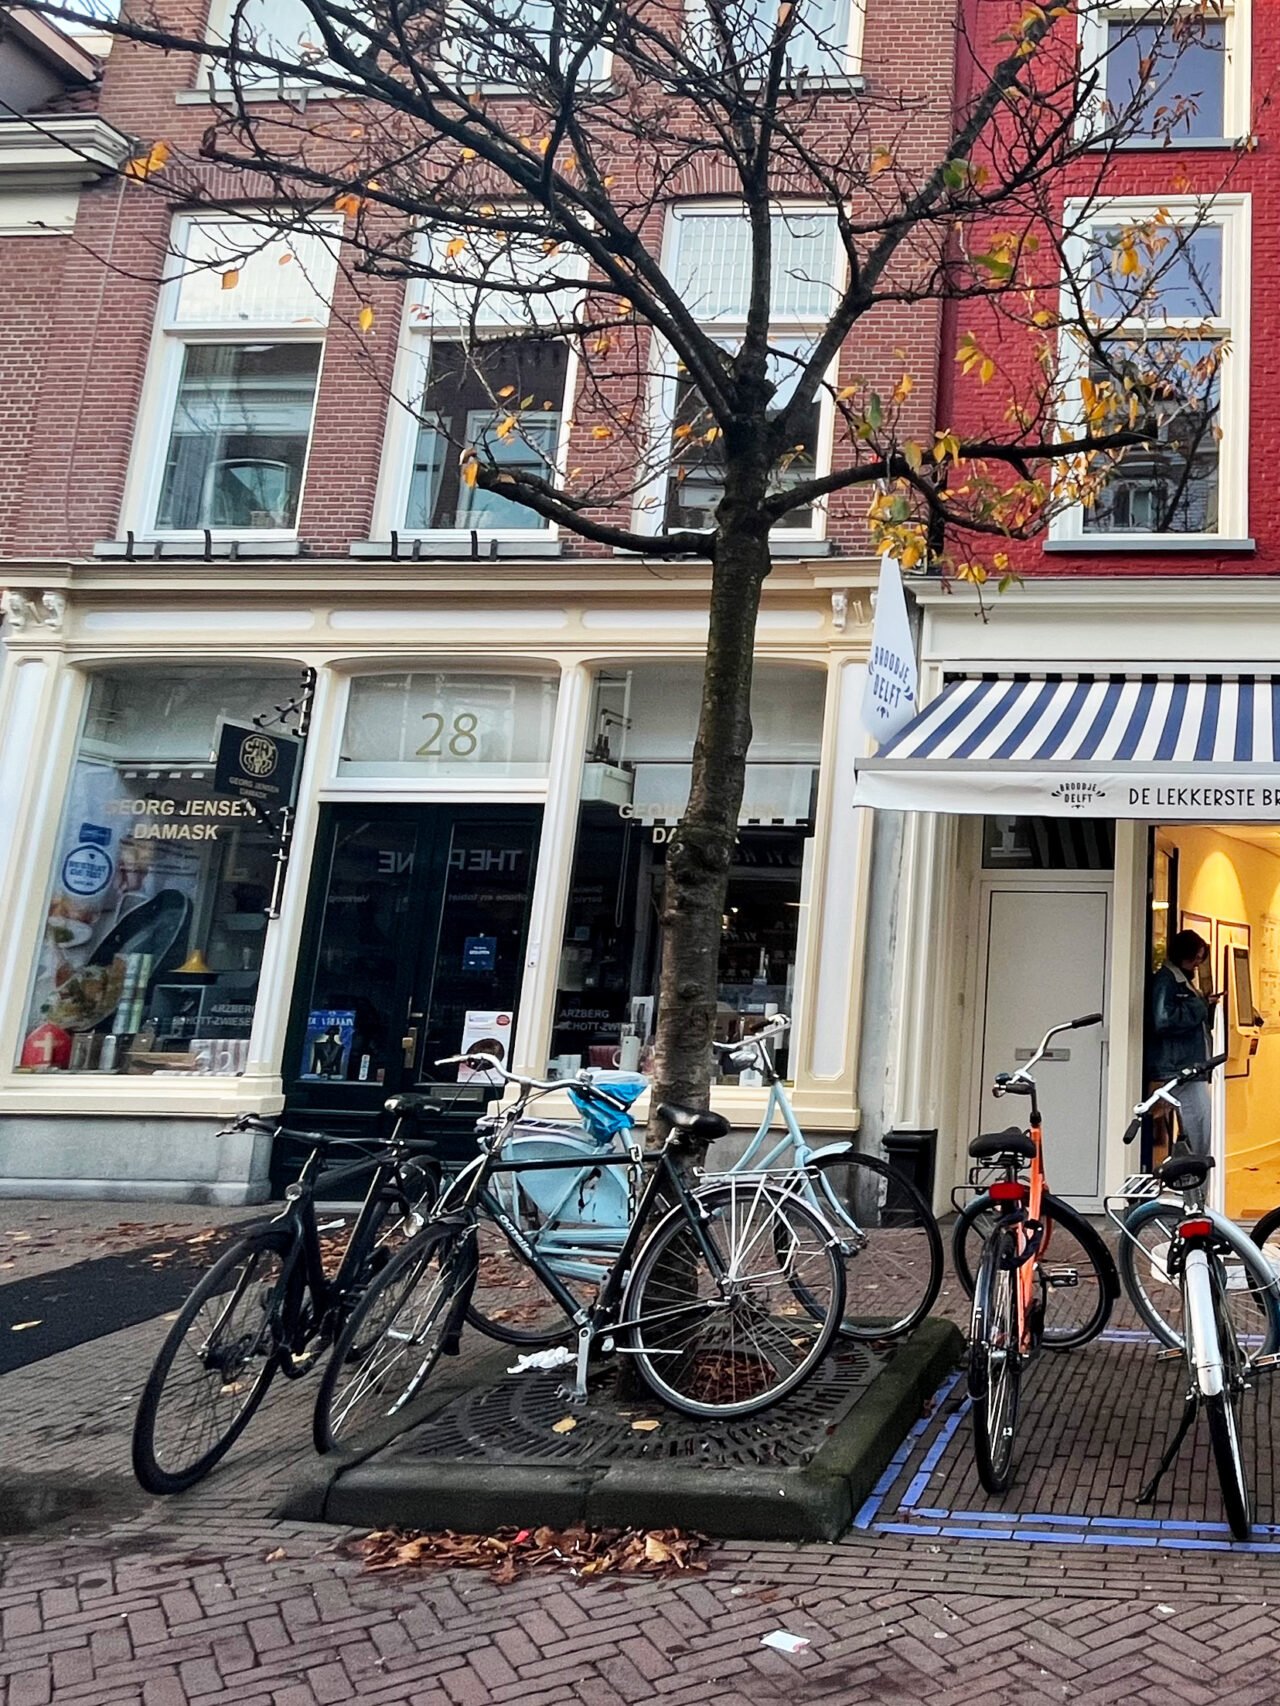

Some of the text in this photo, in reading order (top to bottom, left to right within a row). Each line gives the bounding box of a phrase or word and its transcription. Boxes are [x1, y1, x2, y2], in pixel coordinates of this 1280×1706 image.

[874, 646, 910, 684] BROODJE
[873, 673, 901, 708] DELFT
[416, 713, 478, 756] 28
[1060, 783, 1097, 793] BROODJE
[1064, 793, 1092, 803] DELFT
[1130, 788, 1150, 805] DE
[1157, 788, 1255, 806] LEKKERSTE
[134, 824, 219, 839] DAMASK
[211, 1004, 255, 1014] ARZBER
[560, 1009, 610, 1018] ARZBERG
